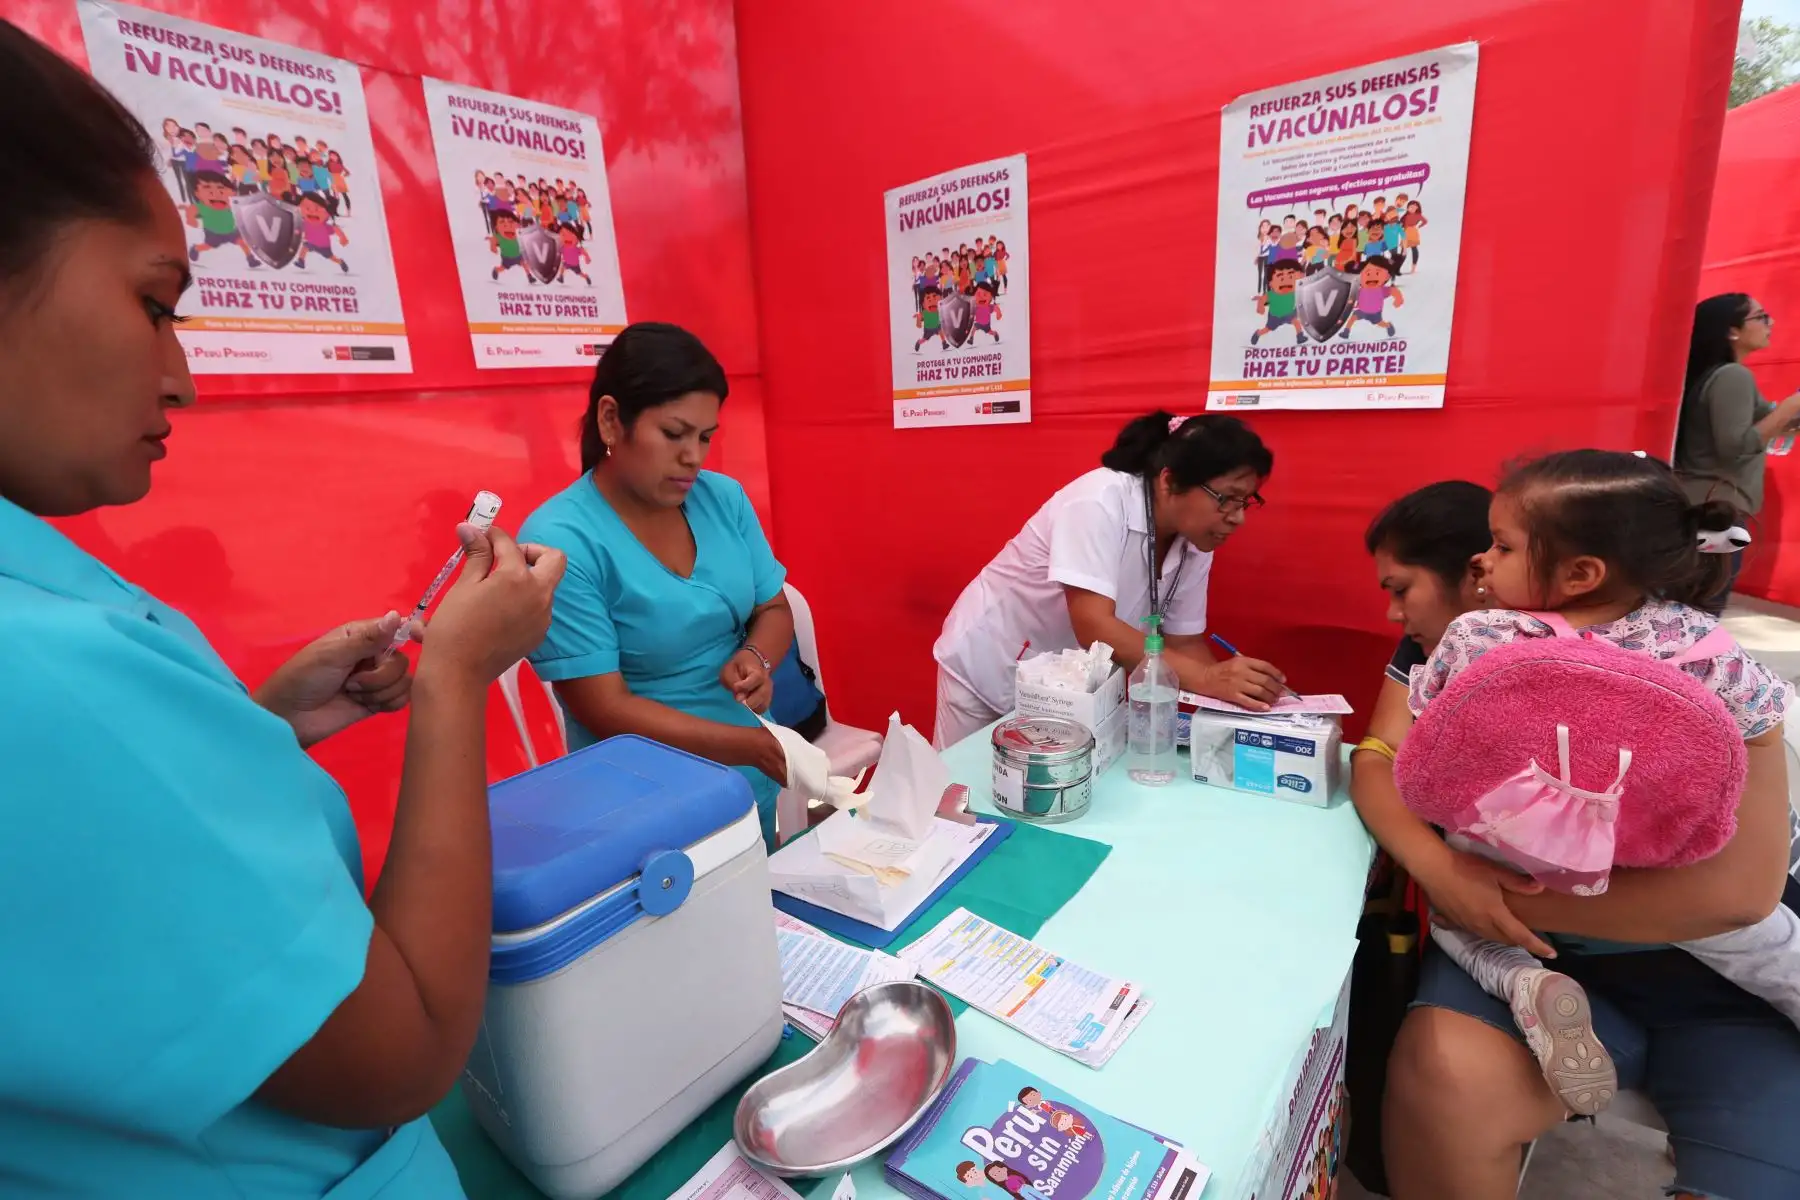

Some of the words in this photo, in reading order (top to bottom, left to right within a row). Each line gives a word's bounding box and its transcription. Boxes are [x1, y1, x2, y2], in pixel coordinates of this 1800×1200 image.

[117, 19, 213, 55] REFUERZA
[219, 45, 255, 64] SUS
[260, 53, 336, 84] DEFENSAS
[124, 43, 342, 115] ¡VACÚNALOS!
[1249, 90, 1322, 119] REFUERZA
[1325, 81, 1357, 103] SUS
[1361, 62, 1441, 94] DEFENSAS
[447, 95, 507, 117] REFUERZA
[509, 108, 533, 123] SUS
[534, 113, 582, 134] DEFENSAS
[1247, 85, 1440, 148] ¡VACÚNALOS!
[451, 114, 586, 160] ¡VACÚNALOS!
[898, 186, 939, 208] REFUERZA
[940, 180, 958, 196] SUS
[960, 168, 1009, 190] DEFENSAS
[1250, 195, 1263, 204] Las
[1264, 191, 1293, 202] Vacunas
[1295, 188, 1308, 197] son
[1309, 184, 1340, 197] seguras,
[1341, 177, 1377, 191] efectivas
[1377, 177, 1384, 186] y
[1384, 169, 1425, 184] gratuitas!
[899, 187, 1010, 232] ¡VACÚNALOS!
[256, 214, 282, 243] V
[532, 241, 549, 264] V
[198, 277, 256, 291] PROTEGE
[260, 281, 268, 291] A
[272, 281, 287, 293] TU
[289, 283, 356, 296] COMUNIDAD
[498, 292, 534, 302] PROTEGE
[536, 294, 542, 302] A
[542, 293, 552, 302] TU
[554, 294, 597, 304] COMUNIDAD
[201, 290, 254, 309] ¡HAZ
[257, 293, 285, 310] TU
[291, 294, 360, 314] PARTE!
[499, 302, 532, 316] ¡HAZ
[533, 303, 550, 317] TU
[555, 304, 598, 318] PARTE!
[1314, 289, 1339, 317] V
[950, 308, 964, 329] V
[916, 358, 945, 369] PROTEGE
[946, 357, 952, 366] A
[952, 357, 961, 365] TU
[962, 352, 1002, 364] COMUNIDAD
[1244, 347, 1297, 360] PROTEGE
[1299, 345, 1308, 357] A
[1311, 344, 1327, 356] TU
[1329, 340, 1407, 356] COMUNIDAD
[916, 368, 943, 382] ¡HAZ
[944, 367, 959, 380] TU
[961, 362, 1002, 378] PARTE!
[1243, 360, 1289, 379] ¡HAZ
[1294, 358, 1321, 376] TU
[1326, 354, 1405, 375] PARTE!
[1295, 746, 1312, 755] 200
[1280, 777, 1307, 791] Elite
[961, 1100, 1047, 1163] Perú
[1027, 1136, 1062, 1172] sin
